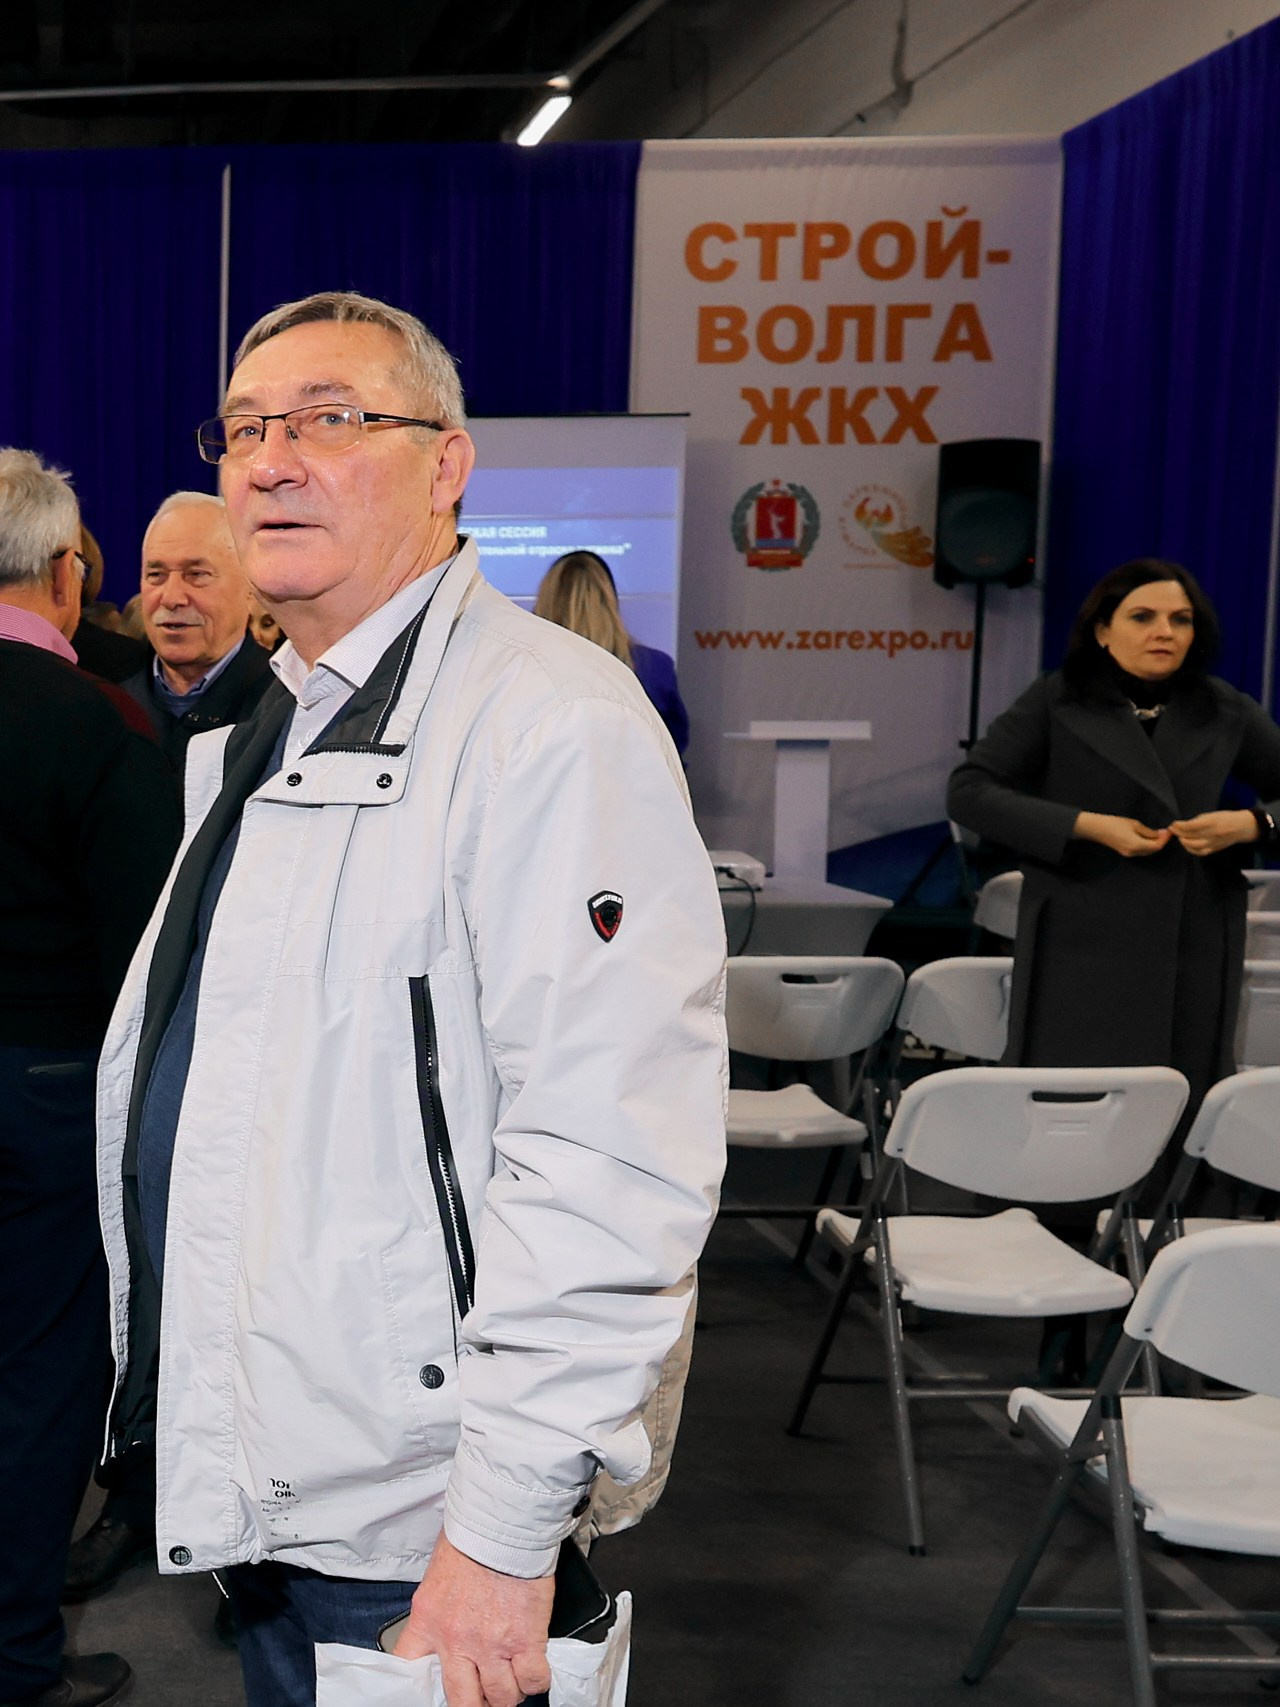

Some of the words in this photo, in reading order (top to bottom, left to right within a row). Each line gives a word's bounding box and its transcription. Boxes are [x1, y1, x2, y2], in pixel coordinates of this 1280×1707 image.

[683, 206, 1011, 283] СТРОЙ-
[696, 303, 993, 364] ВОЛГА
[739, 385, 940, 446] ЖКХ
[694, 629, 974, 658] www.zarexpo.ru
